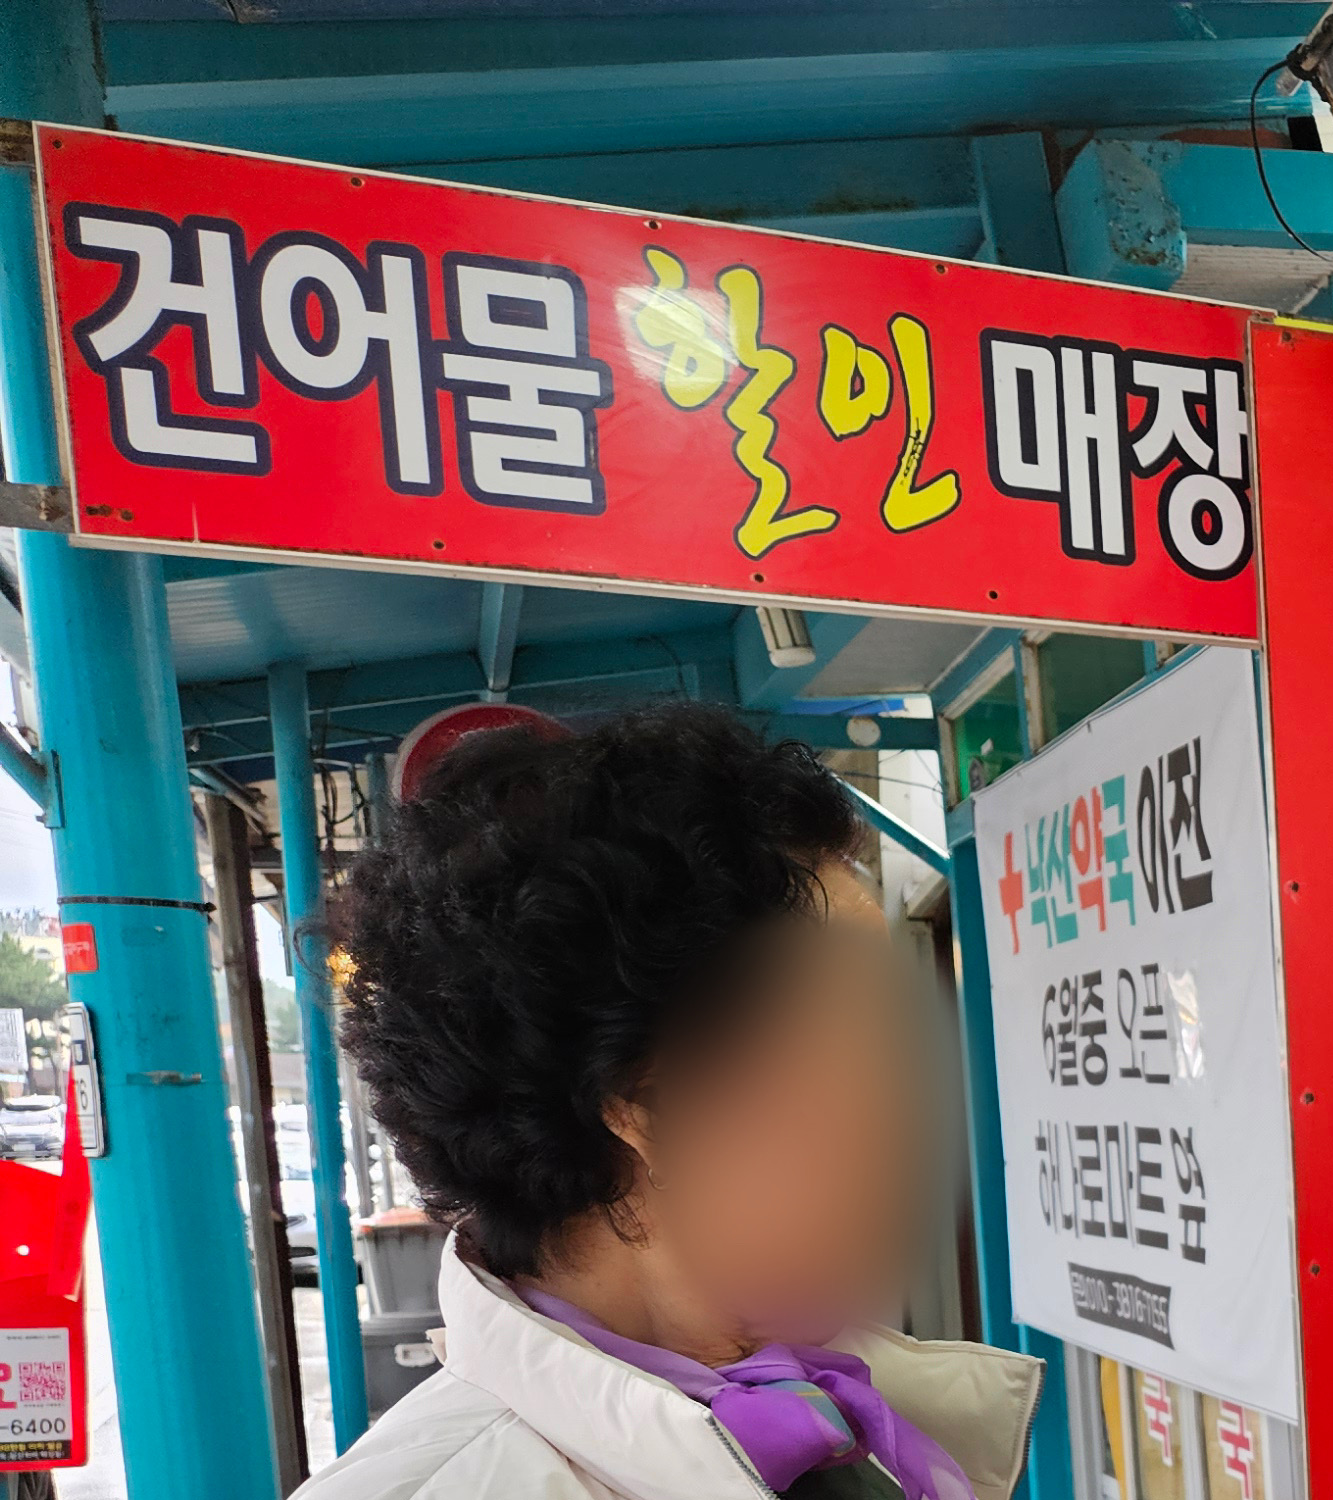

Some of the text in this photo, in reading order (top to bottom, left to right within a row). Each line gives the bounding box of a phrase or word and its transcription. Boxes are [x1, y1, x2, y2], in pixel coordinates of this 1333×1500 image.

[66, 203, 1250, 579] 건어물 할인 매장
[1137, 736, 1213, 914] 이전
[1042, 963, 1171, 1086] 6월중 오픈
[1035, 1119, 1206, 1264] 하나로마트 옆
